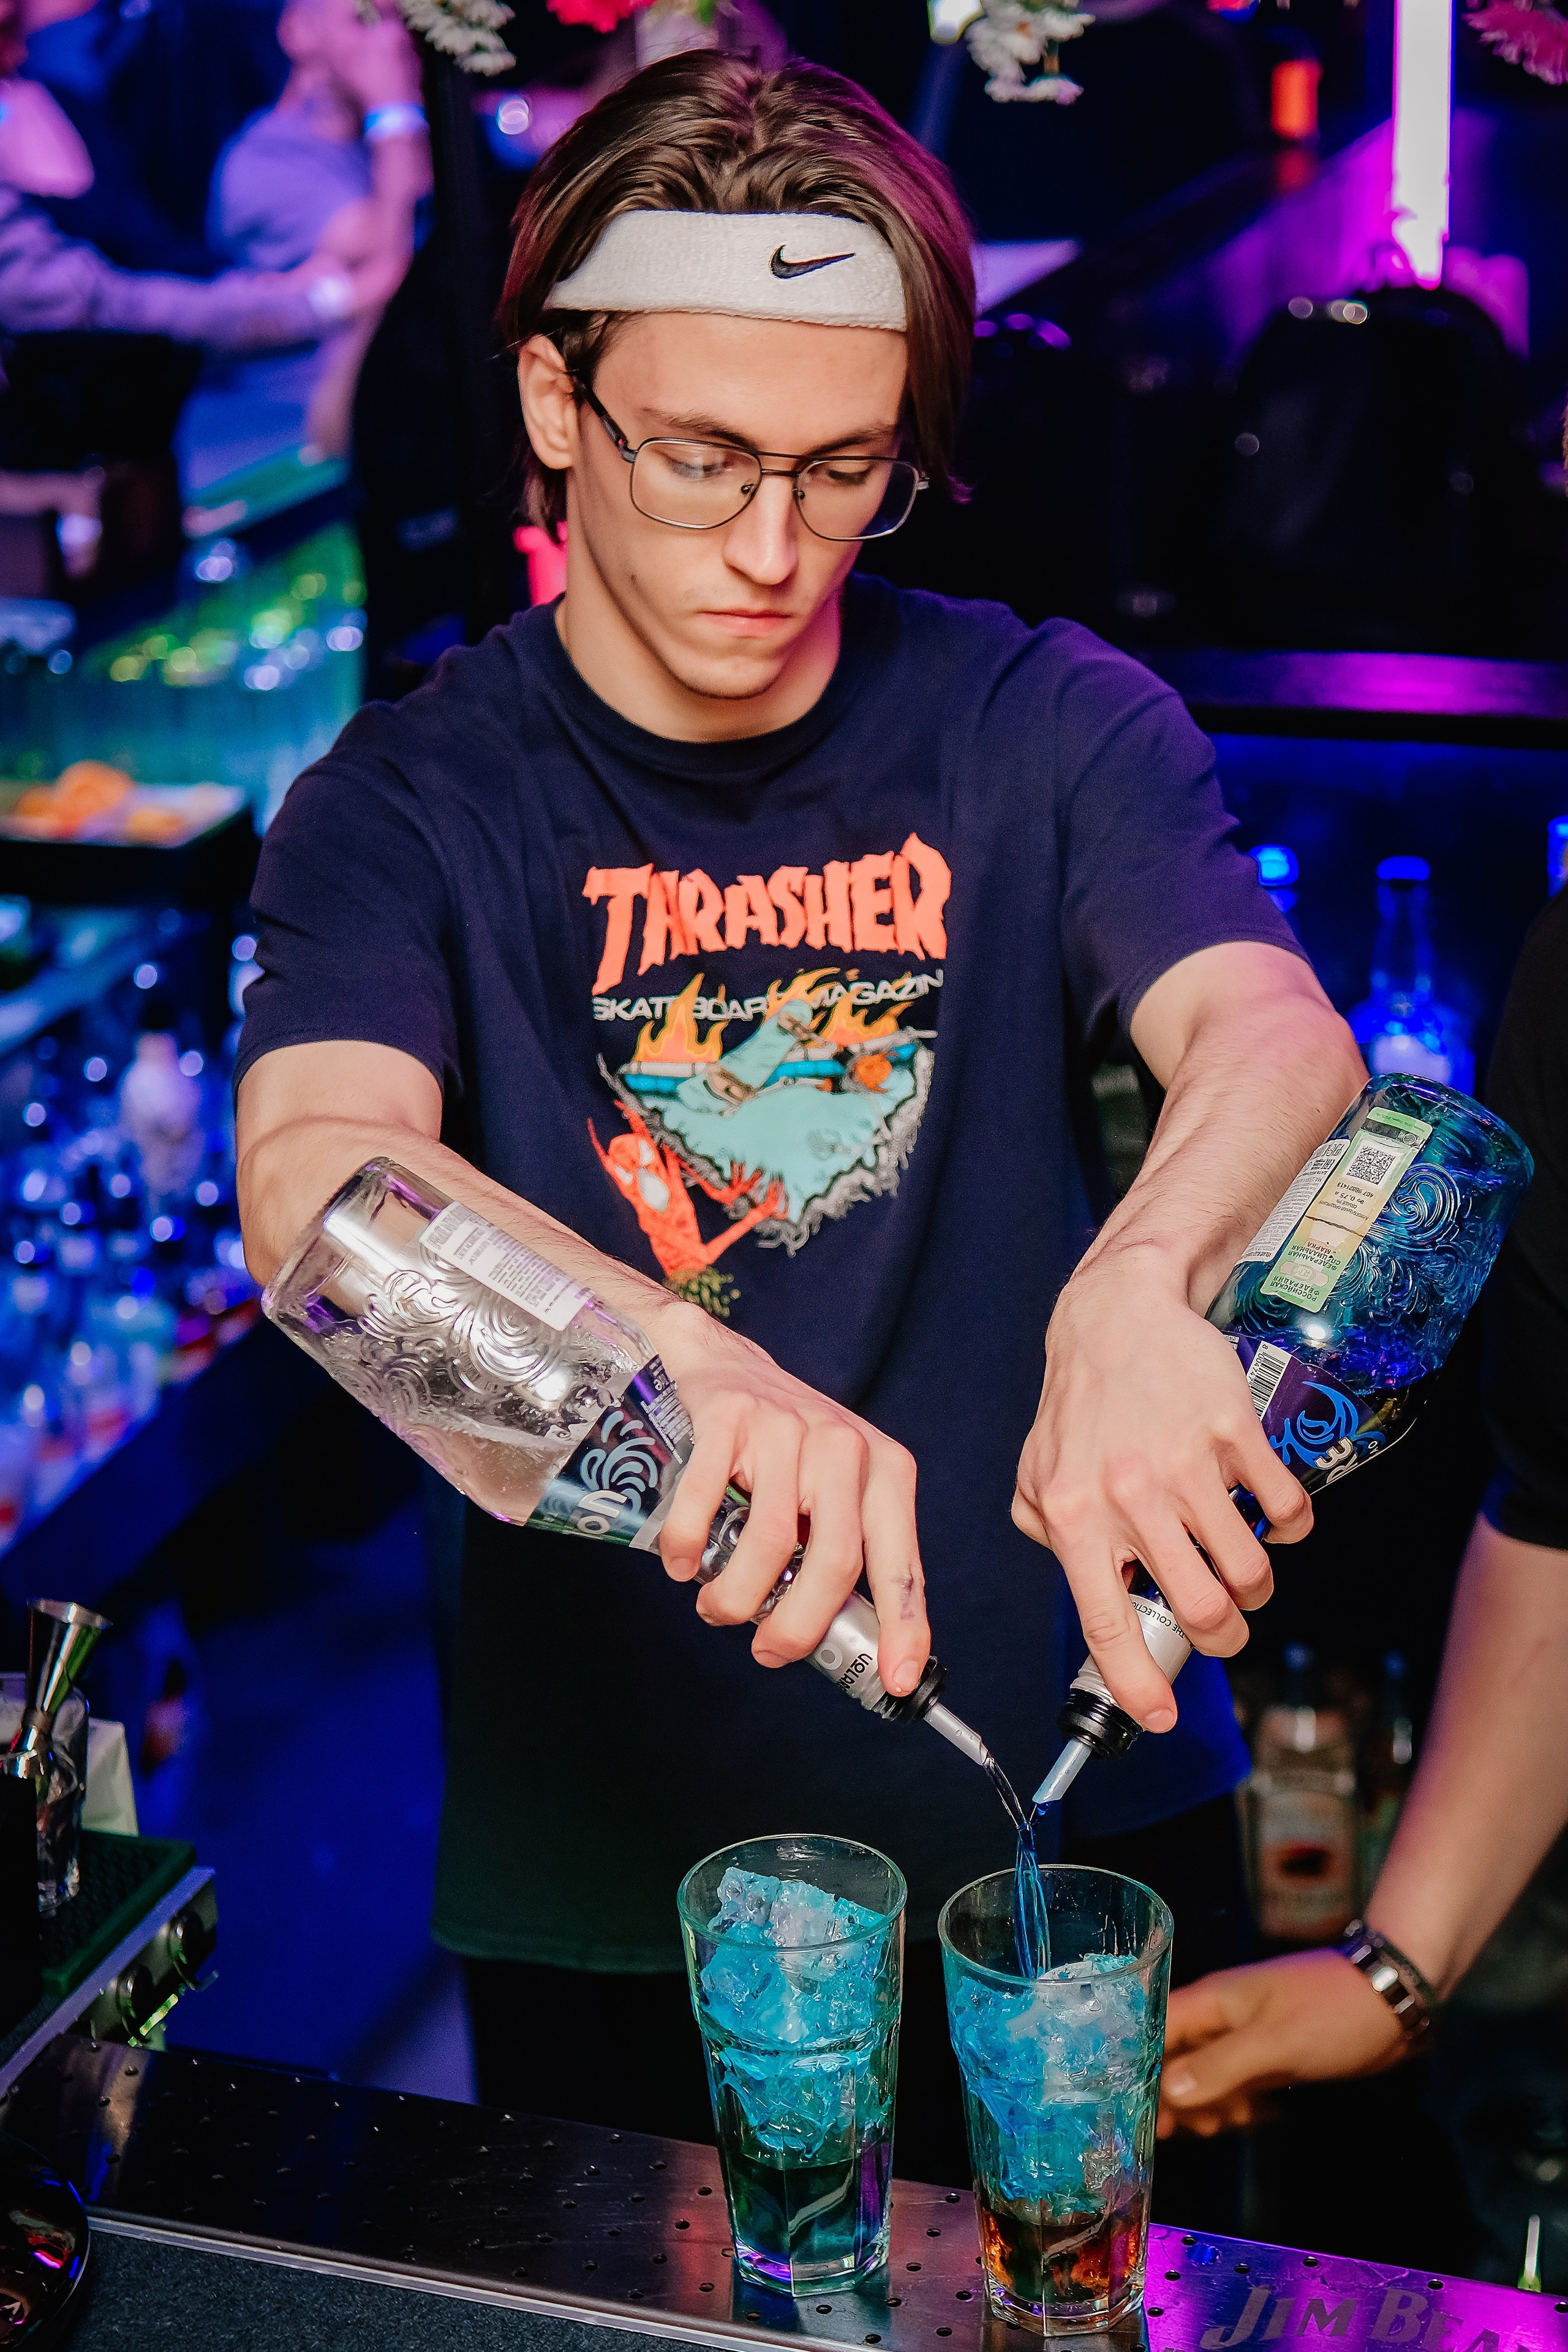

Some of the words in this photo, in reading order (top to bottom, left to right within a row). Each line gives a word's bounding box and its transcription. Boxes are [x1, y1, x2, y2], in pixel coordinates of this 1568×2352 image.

[582, 833, 952, 995] THRASHER
[591, 996, 769, 1021] SKATBOAR
[1306, 1241, 1332, 1254] МАРКА
[1287, 1250, 1338, 1271] ФЕДЕРАЛЬНАЯ
[1270, 1280, 1318, 1302] РОССИЙСКАЯ
[1273, 1275, 1320, 1296] ФЕДЕРАЦИЯ
[1132, 1602, 1172, 1627] COLLECTIO
[1200, 2285, 1357, 2351] JIM
[1368, 2286, 1531, 2352] BEA
